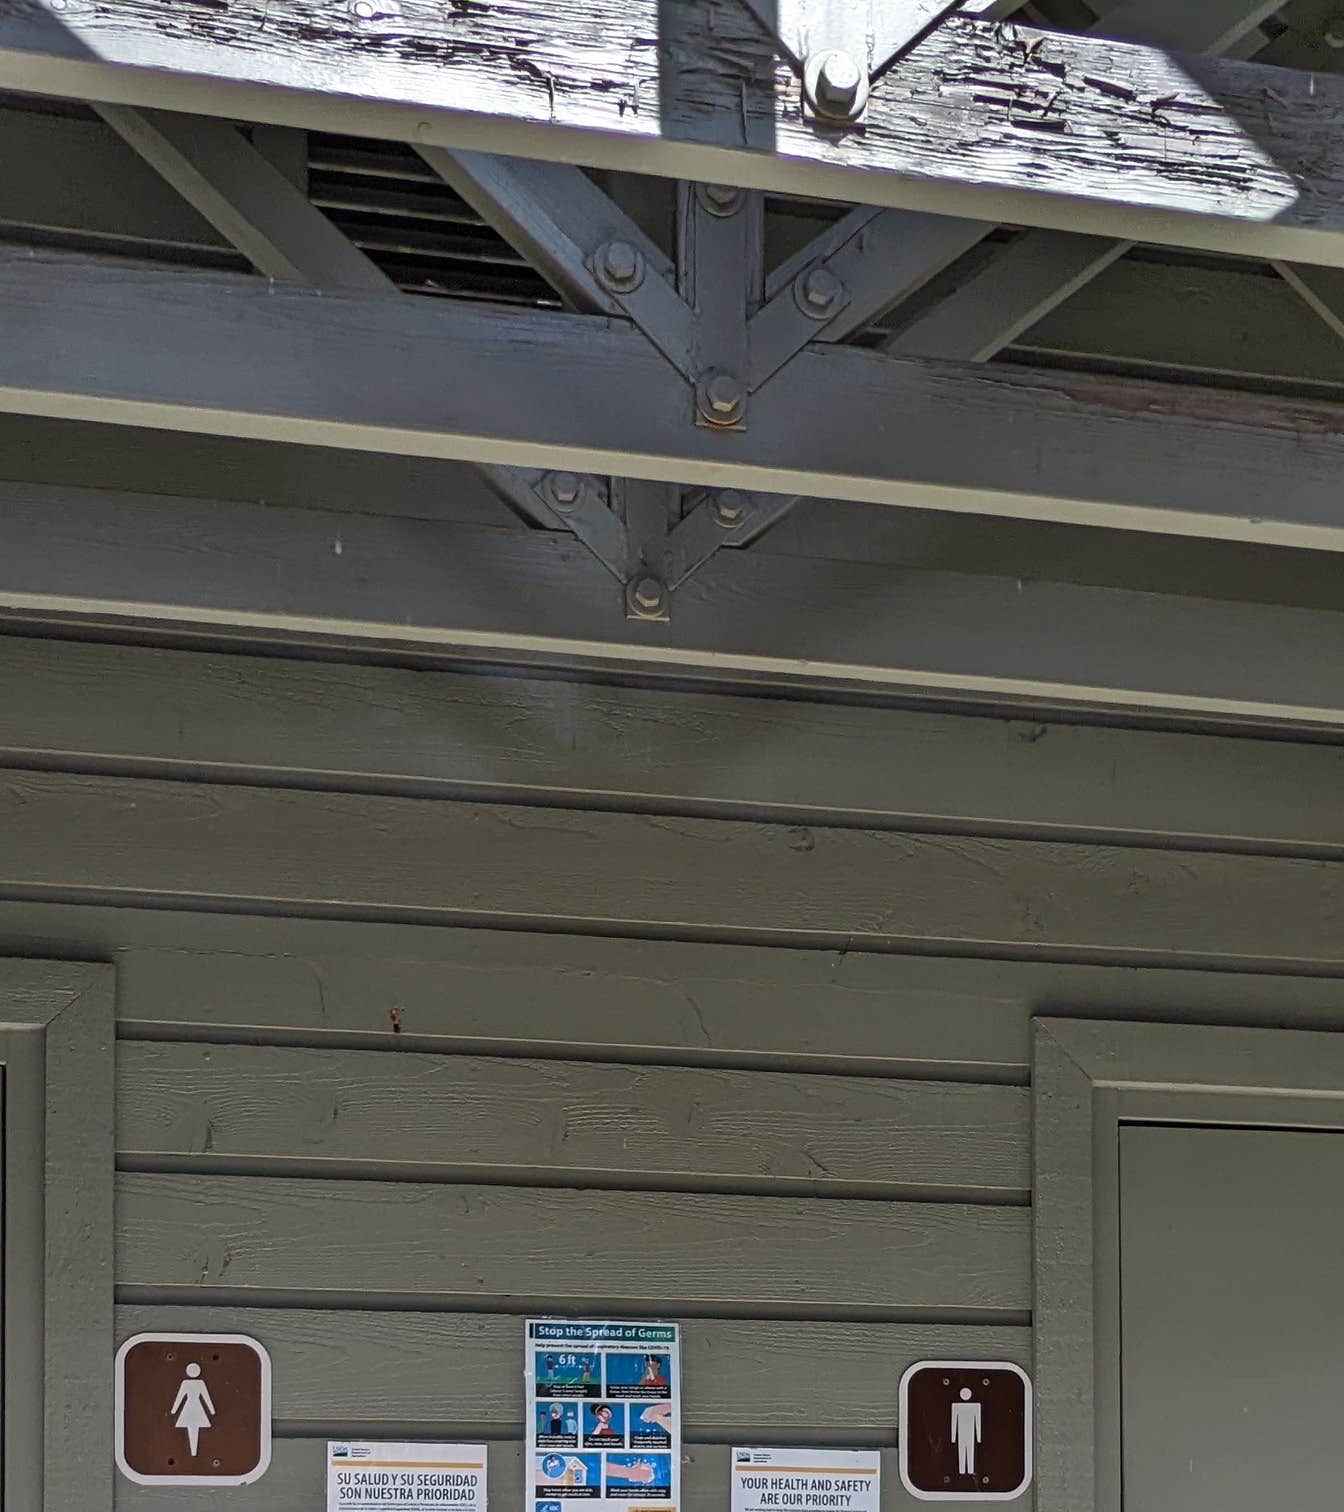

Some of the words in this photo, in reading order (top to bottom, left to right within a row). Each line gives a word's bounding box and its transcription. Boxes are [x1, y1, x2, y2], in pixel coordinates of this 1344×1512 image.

[539, 1326, 563, 1337] Stop
[566, 1327, 584, 1336] the
[586, 1327, 622, 1338] Spread
[625, 1328, 635, 1337] of
[638, 1329, 672, 1338] Germs
[558, 1354, 566, 1365] 6
[567, 1354, 576, 1365] ft
[337, 1473, 351, 1485] SU
[354, 1473, 389, 1486] SALUD
[391, 1474, 398, 1485] Y
[400, 1474, 414, 1486] SU
[417, 1474, 478, 1487] SEGURIDAD
[741, 1477, 768, 1489] YOUR
[771, 1478, 809, 1491] HEALTH
[811, 1480, 832, 1491] AND
[835, 1480, 871, 1492] SAFETY
[339, 1487, 361, 1499] SON
[364, 1488, 413, 1500] NUESTRA
[416, 1488, 475, 1501] PRIORIDAD
[760, 1493, 779, 1505] ARE
[782, 1494, 802, 1505] OUR
[806, 1494, 852, 1507] PRIORITY
